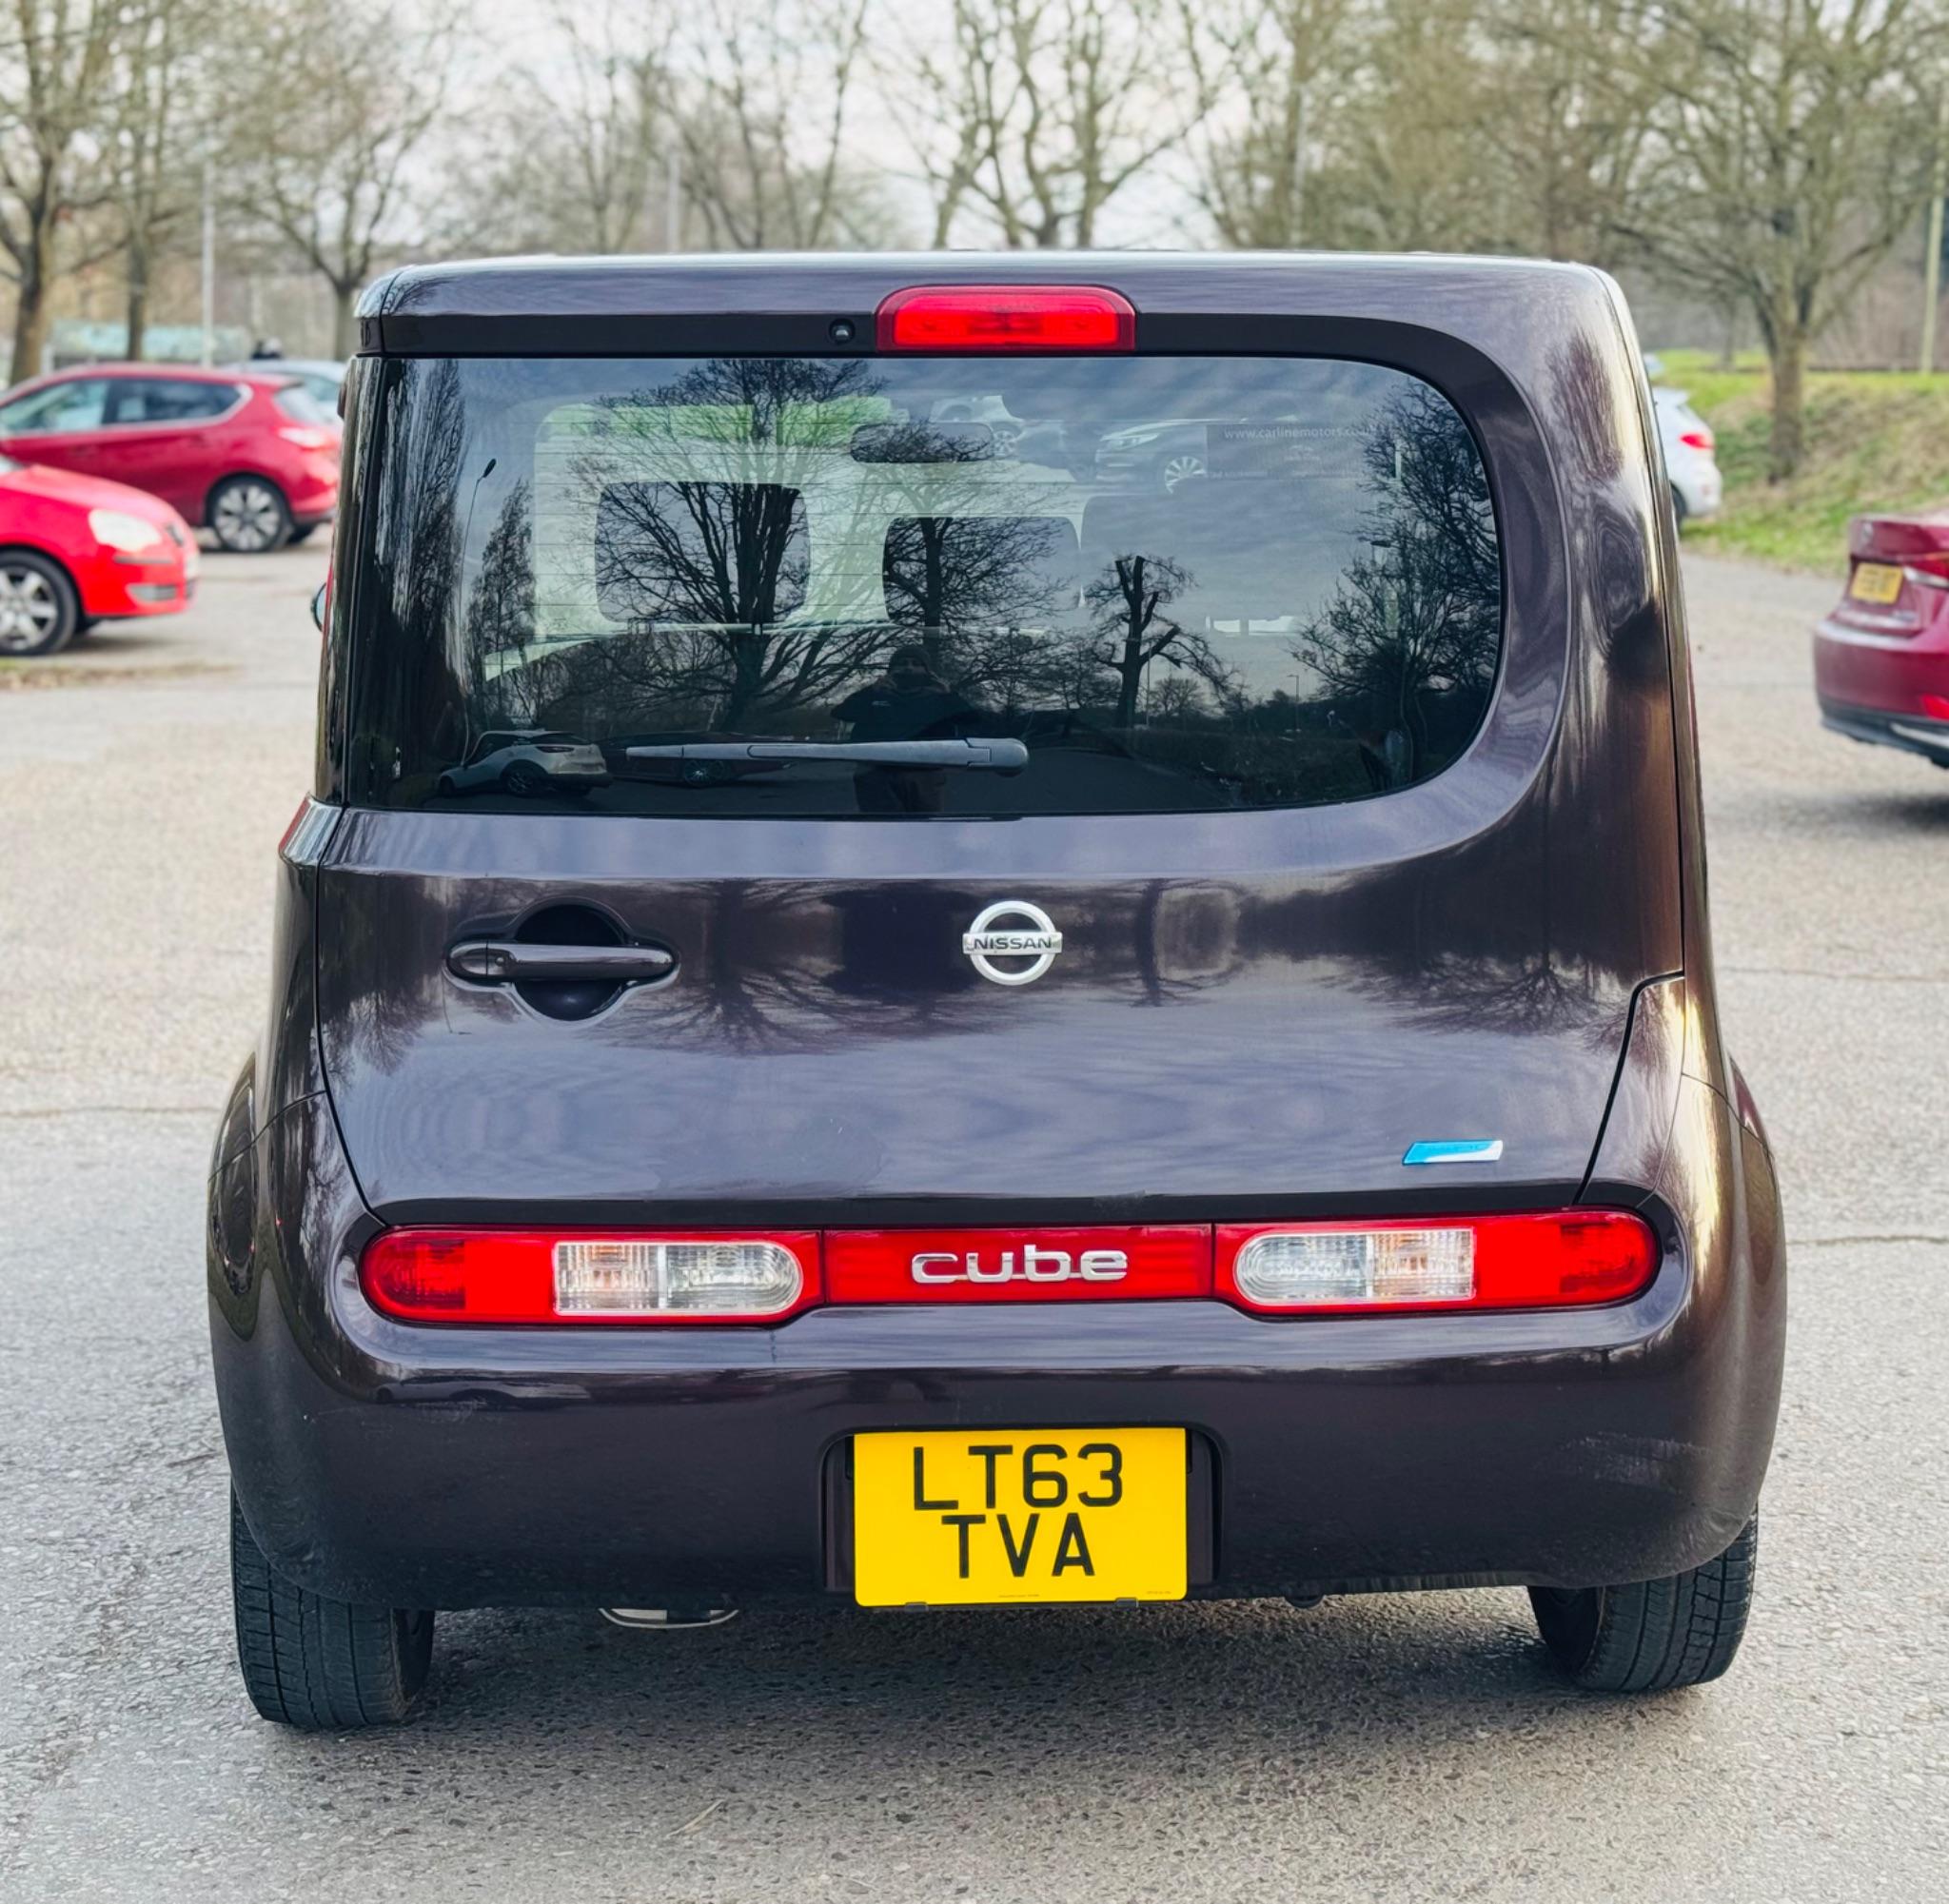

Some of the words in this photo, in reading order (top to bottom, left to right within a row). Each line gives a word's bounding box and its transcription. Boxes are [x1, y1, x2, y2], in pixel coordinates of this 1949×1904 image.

[973, 936, 1052, 950] NISSAN
[912, 1245, 1129, 1284] cube
[914, 1443, 1123, 1511] LT63
[941, 1512, 1095, 1579] TVA
